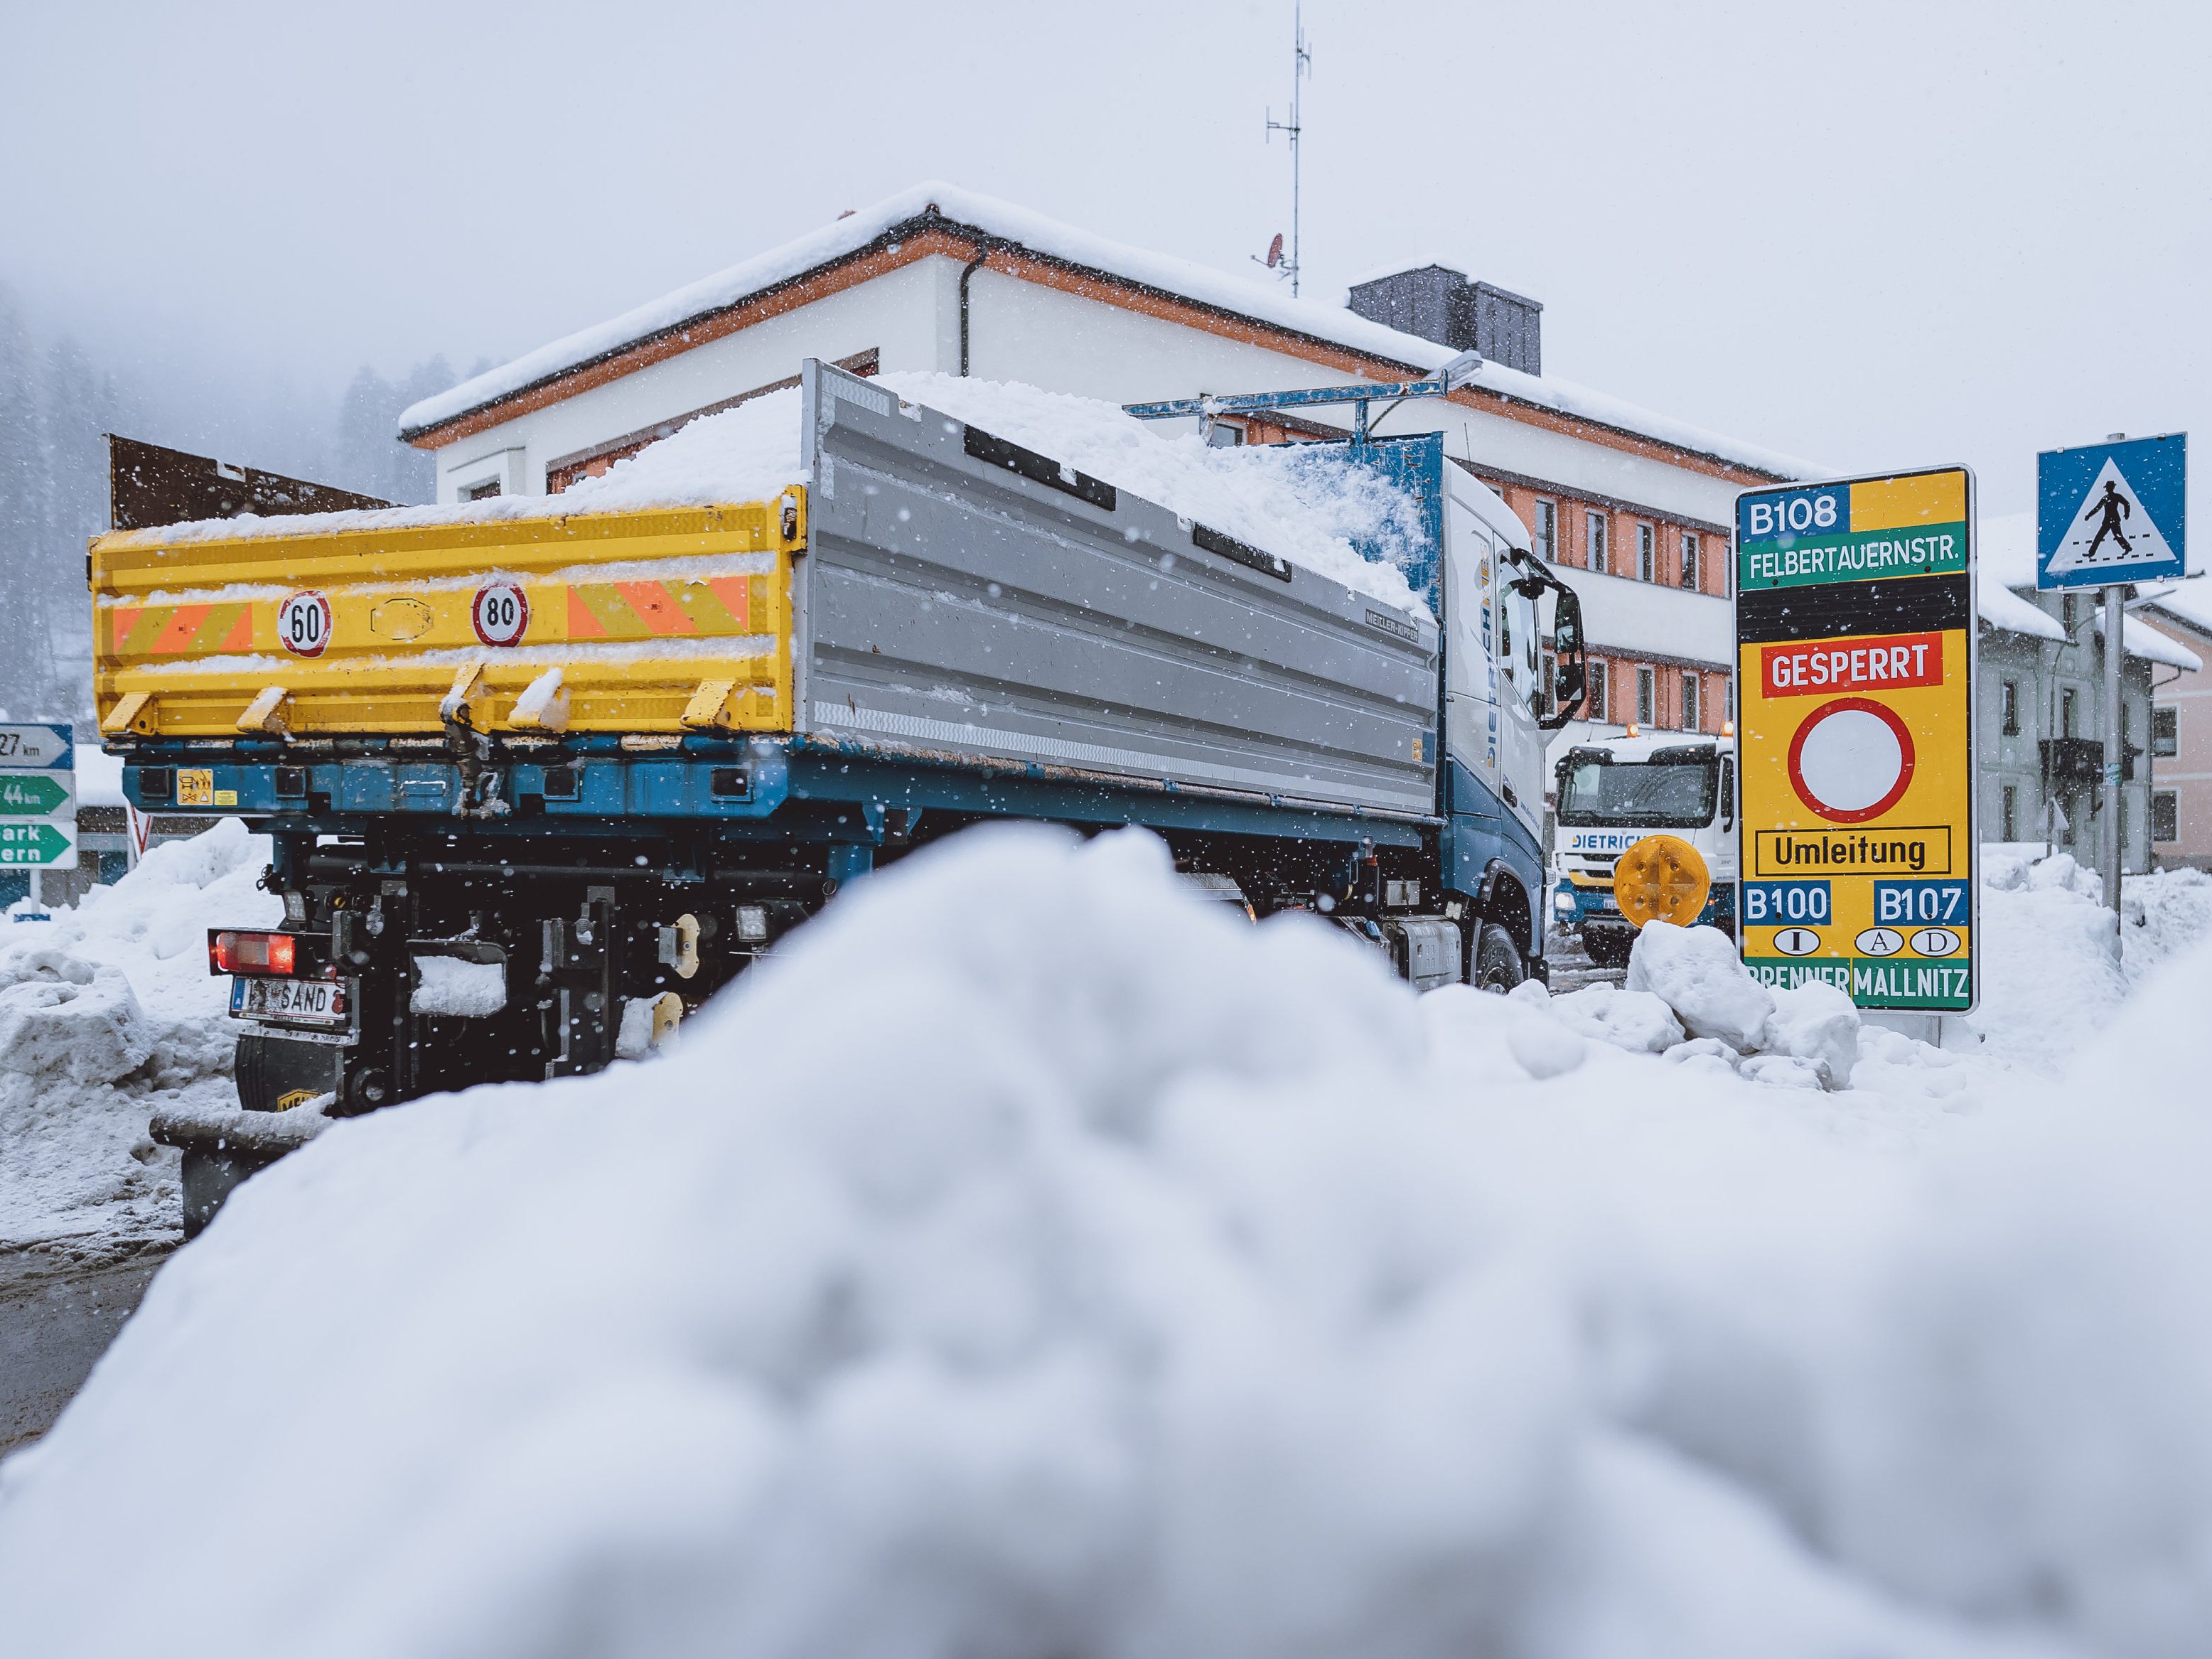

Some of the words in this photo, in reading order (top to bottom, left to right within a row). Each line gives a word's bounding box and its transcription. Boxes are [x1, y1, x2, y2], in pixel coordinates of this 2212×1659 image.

[1750, 495, 1837, 535] B108
[1749, 534, 1960, 579] FELBERTAUERNSTR.
[291, 604, 319, 643] 60
[487, 597, 514, 626] 80
[1366, 611, 1418, 643] MEILLER-KIPPER
[1771, 644, 1928, 687] GESPERRT
[23, 742, 40, 756] km
[3, 784, 23, 805] 44
[24, 792, 41, 805] km
[1572, 834, 1647, 849] DIETRIC
[1775, 835, 1926, 871] Umleitung
[1746, 887, 1827, 920] B100
[1880, 888, 1963, 920] B107
[1790, 931, 1803, 952] I
[1869, 931, 1891, 952] A
[1926, 932, 1948, 952] D
[1853, 967, 1969, 998] MALLNITZ
